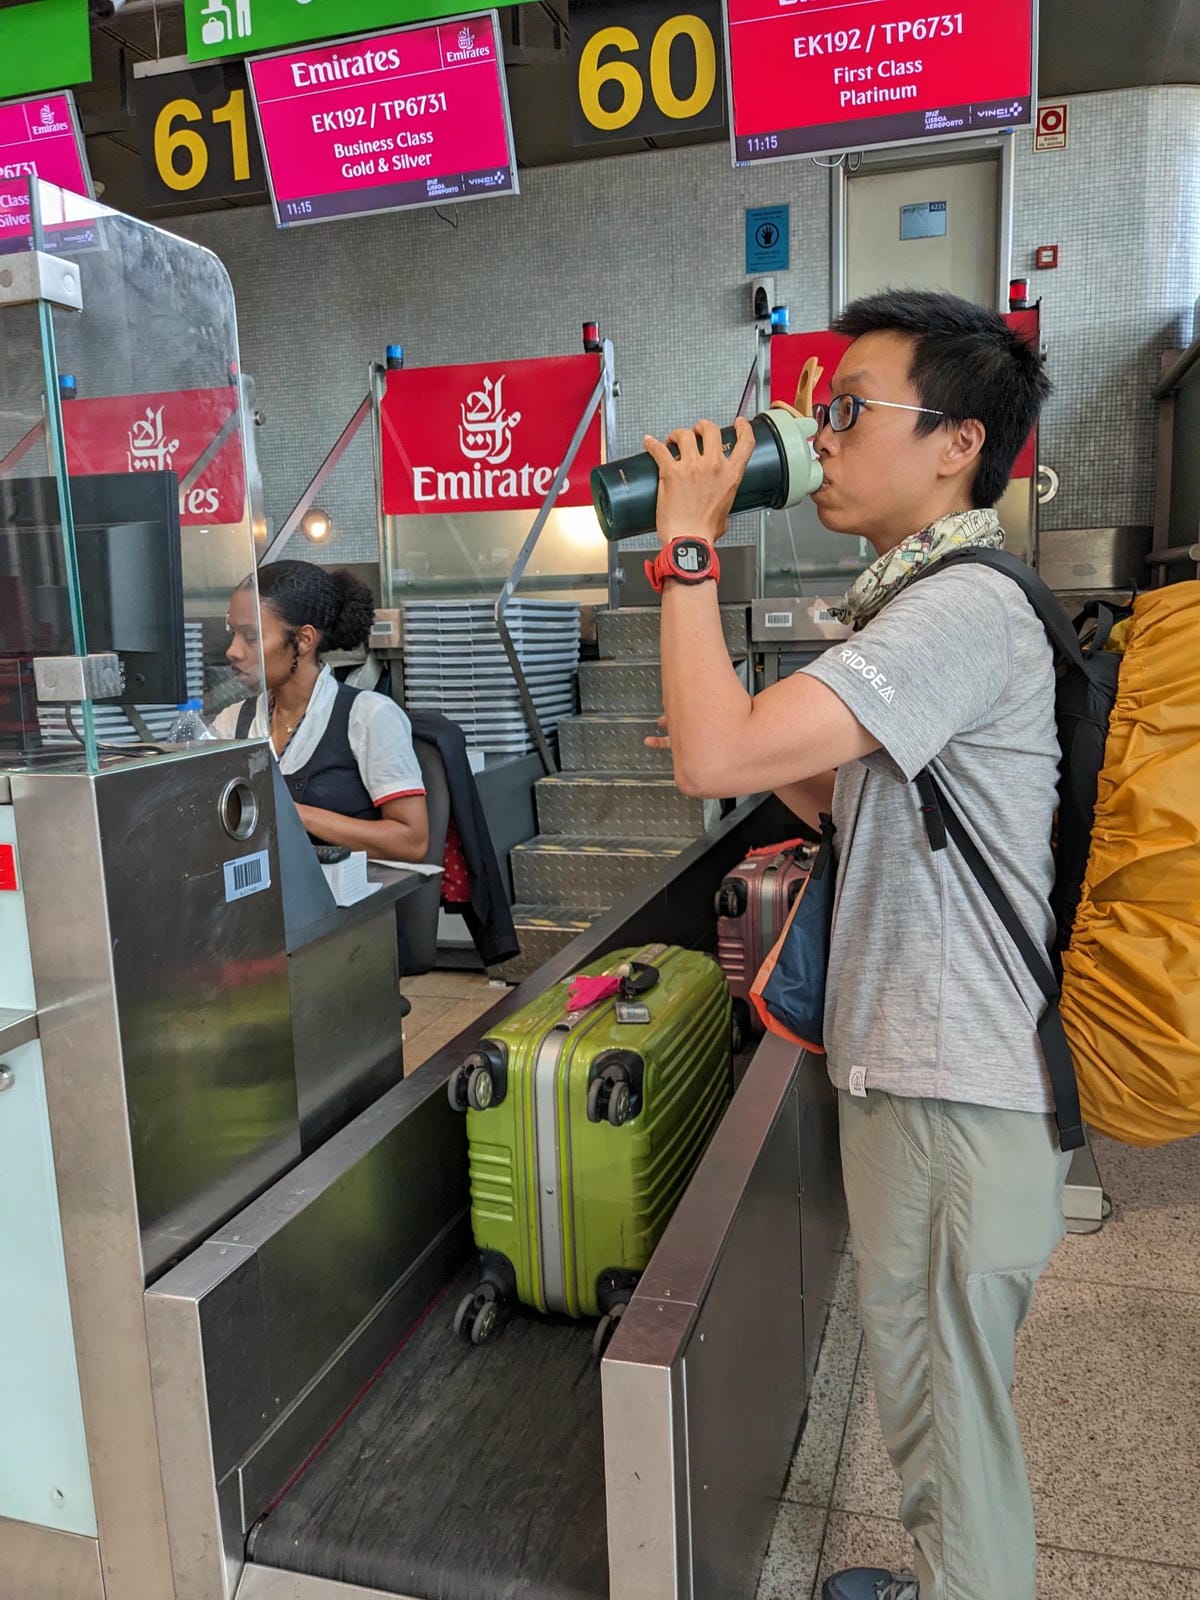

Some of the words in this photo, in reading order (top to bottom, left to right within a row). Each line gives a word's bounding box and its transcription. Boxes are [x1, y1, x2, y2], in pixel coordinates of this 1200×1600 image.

[793, 28, 862, 58] EK192
[865, 24, 876, 53] /
[880, 12, 964, 45] TP6731
[446, 46, 490, 62] Emirates
[290, 48, 401, 88] Emirates
[578, 14, 716, 131] 60
[833, 65, 874, 85] First
[877, 59, 924, 78] Class
[839, 84, 918, 107] Platinum
[311, 106, 367, 134] EK192
[370, 103, 377, 128] /
[379, 91, 448, 121] TP6731
[925, 115, 947, 124] LISBOA
[32, 122, 69, 135] Emirates
[925, 119, 964, 130] AEROPORTO
[154, 88, 251, 191] 61
[333, 137, 394, 159] Business
[396, 131, 434, 148] Class
[747, 135, 778, 152] 11:15
[0, 160, 39, 178] 6731
[341, 159, 375, 178] Gold
[377, 157, 390, 173] &
[392, 152, 433, 171] Silver
[0, 194, 30, 208] Class
[286, 201, 313, 215] 11:15
[0, 213, 31, 228] Silver
